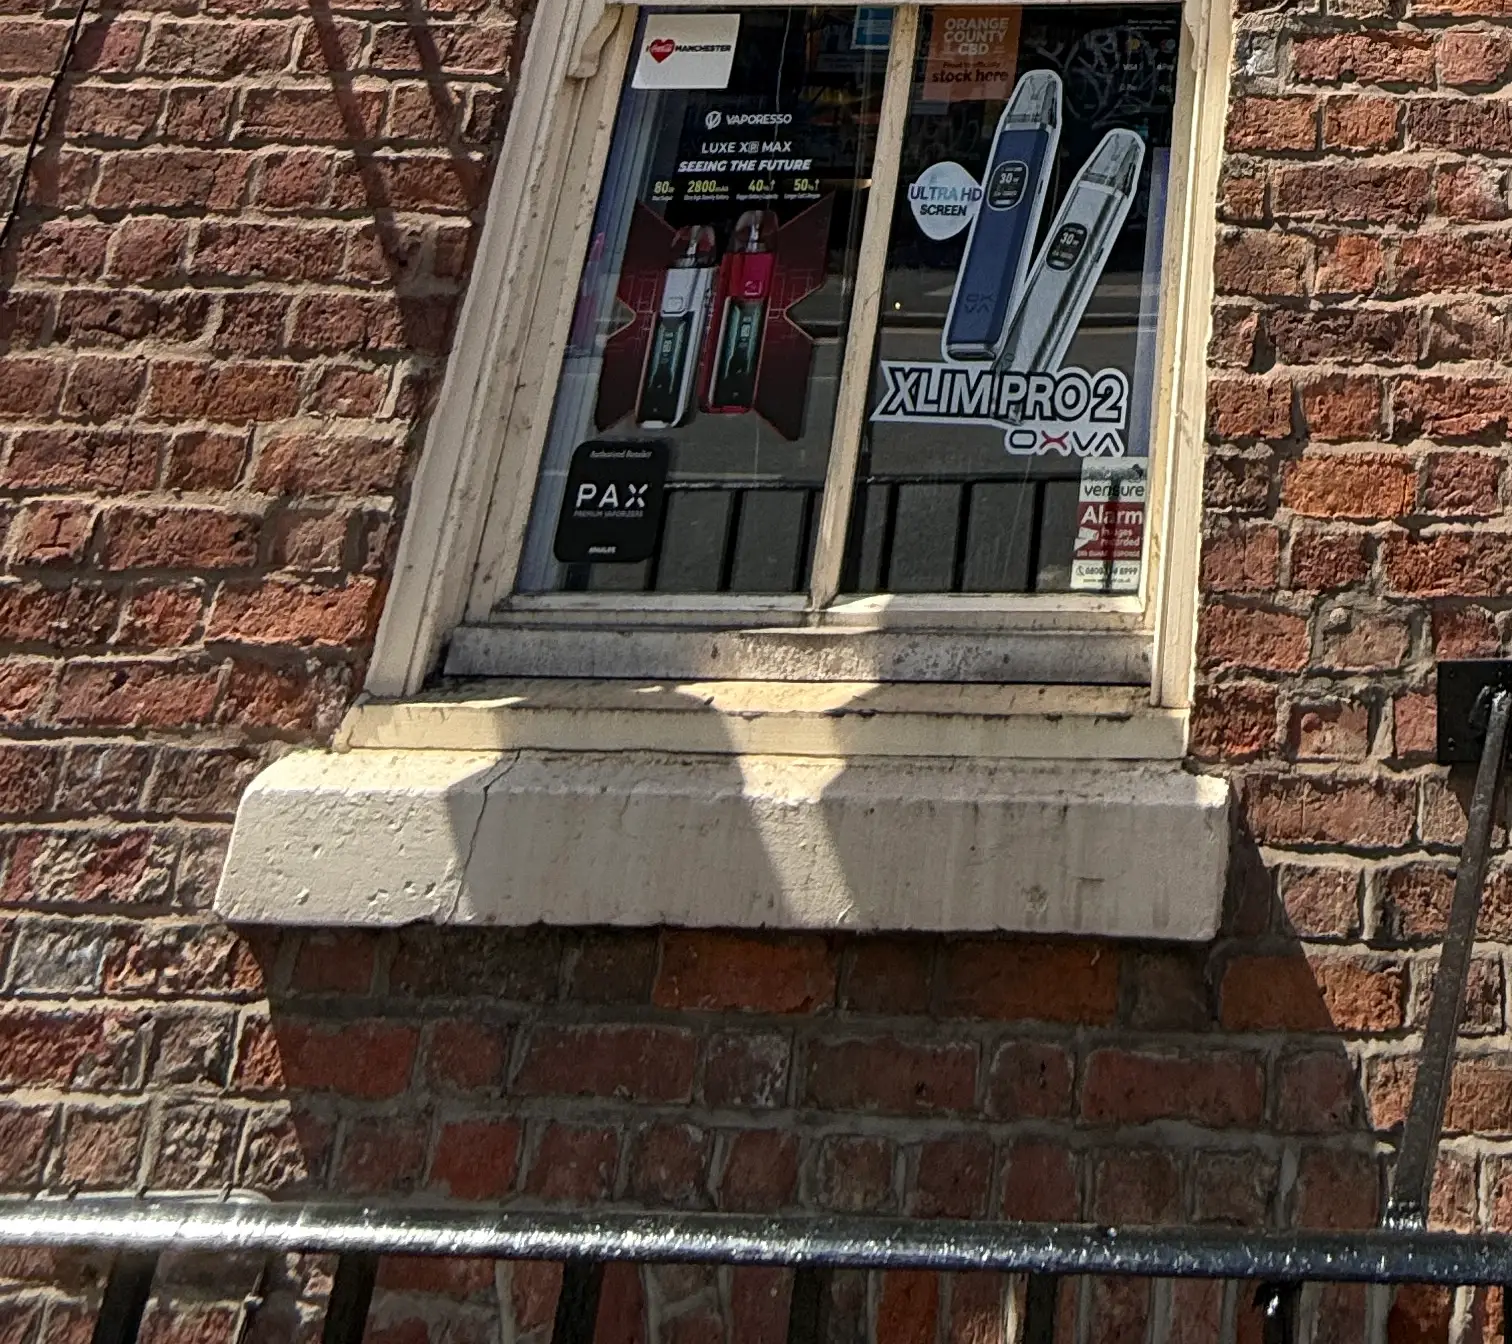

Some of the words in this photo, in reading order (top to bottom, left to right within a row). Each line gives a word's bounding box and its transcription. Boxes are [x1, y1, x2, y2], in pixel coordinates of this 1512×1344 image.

[945, 17, 1010, 30] ORANGE
[943, 30, 1008, 43] COUNTY
[675, 44, 732, 53] MANCHESTER
[958, 43, 990, 55] CBD
[932, 69, 973, 83] stock
[976, 68, 1009, 82] here
[725, 113, 793, 125] VAPORESSO
[701, 141, 736, 154] LUXE
[761, 140, 793, 153] MAX
[677, 160, 727, 173] SEEING
[729, 159, 756, 172] THE
[757, 158, 813, 171] FUTURE
[910, 185, 958, 201] ULTRA
[961, 185, 983, 201] HD
[919, 204, 967, 217] SCREEN
[1009, 429, 1120, 454] OXVA
[576, 483, 649, 508] PAX
